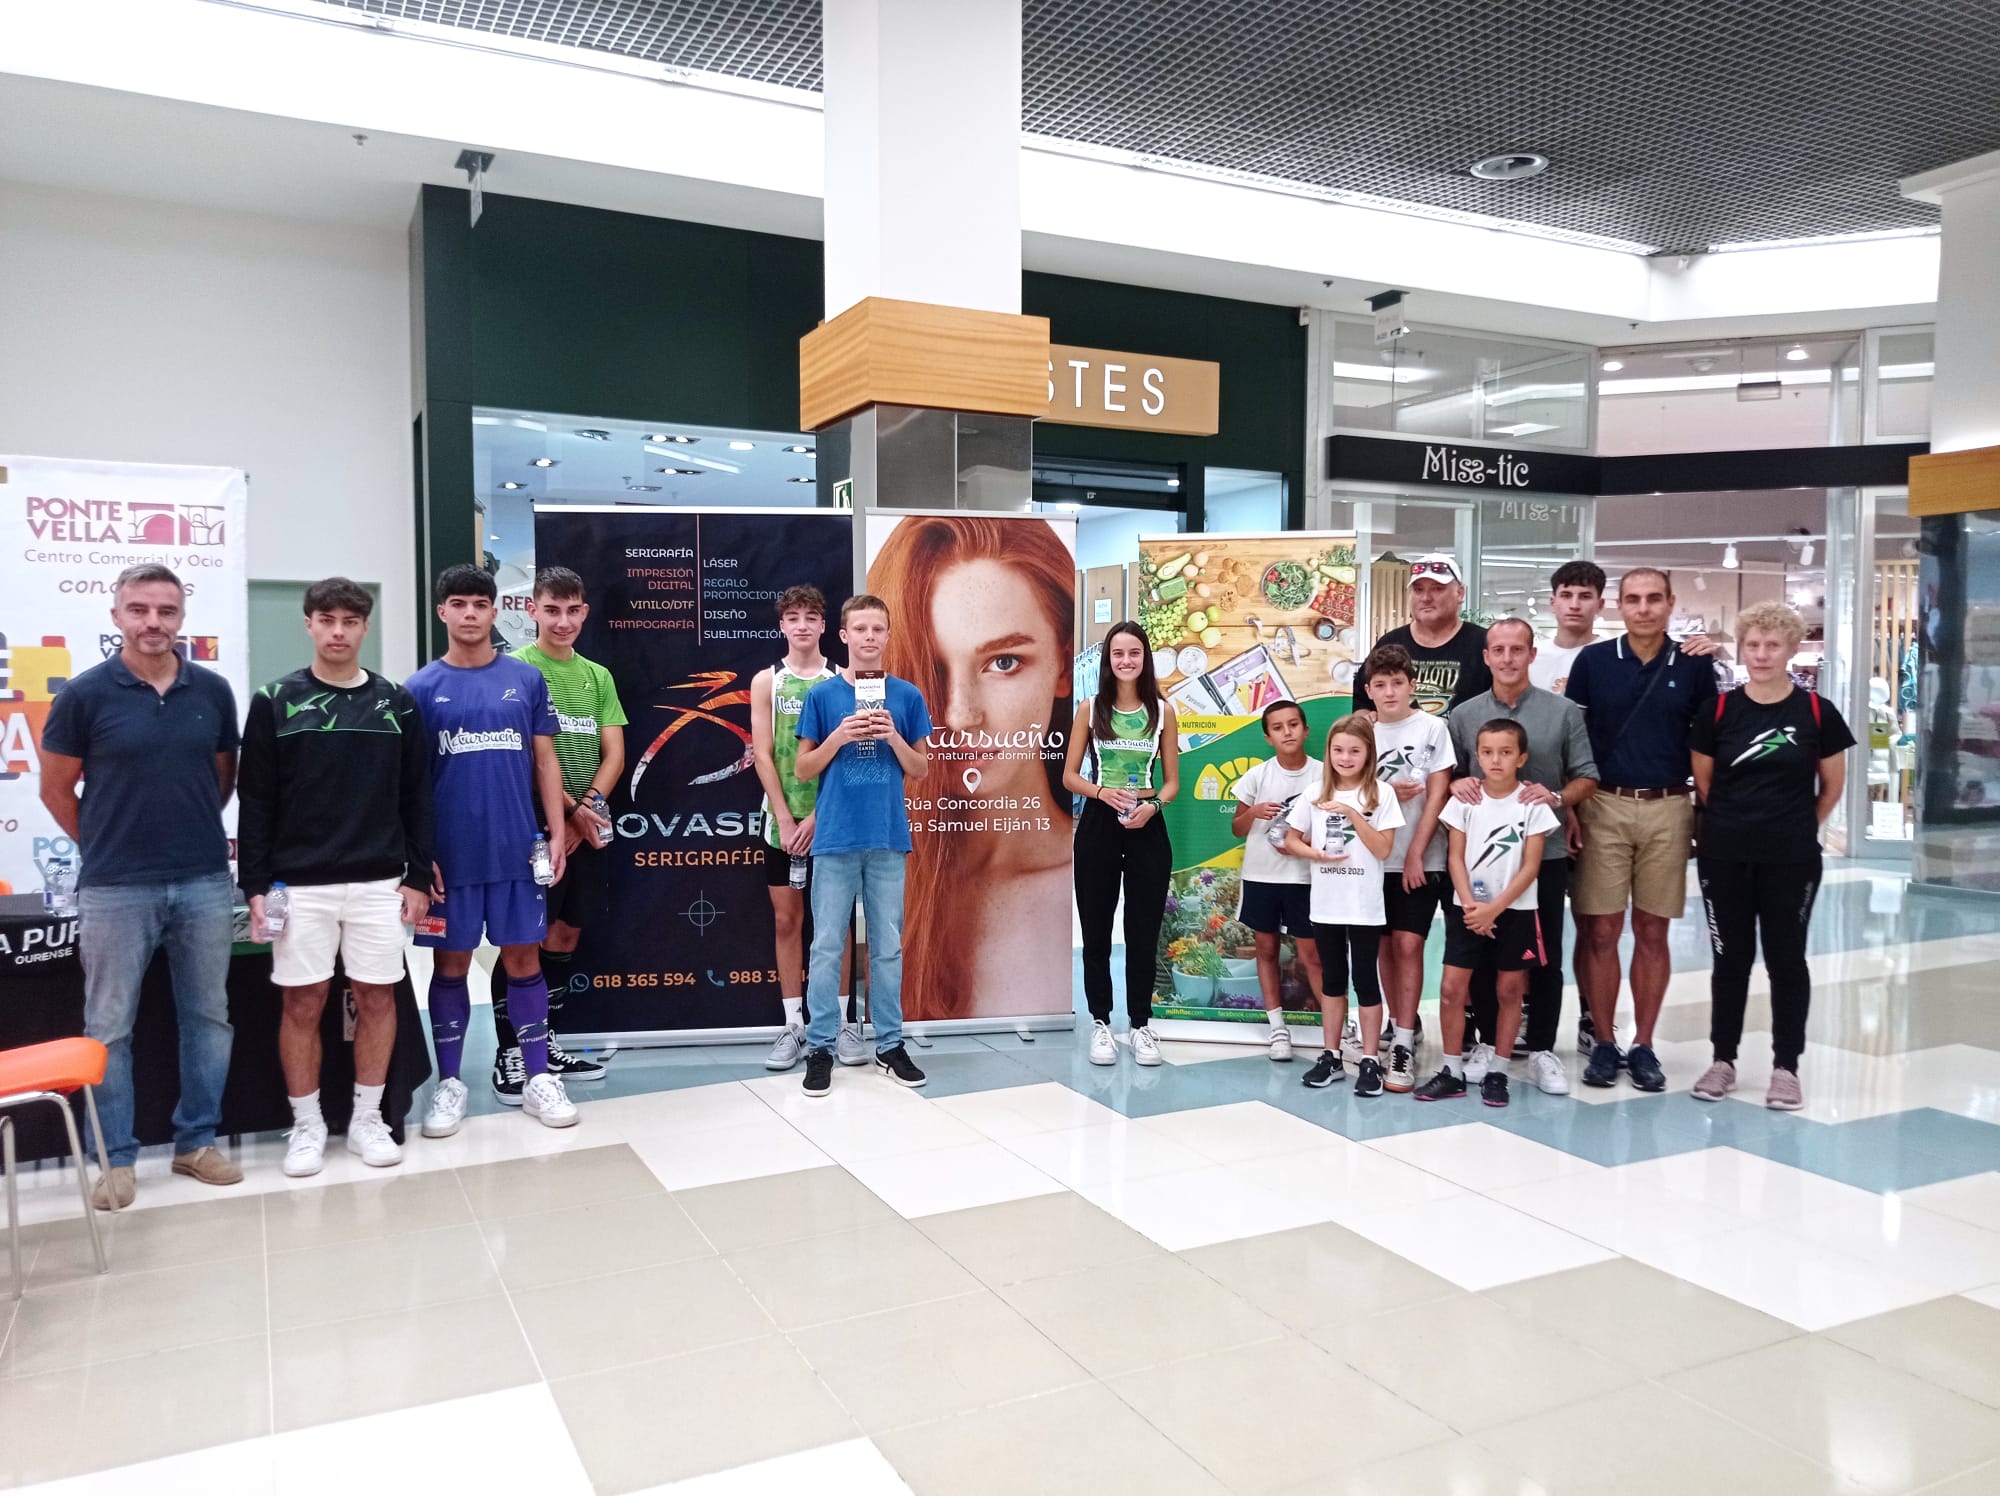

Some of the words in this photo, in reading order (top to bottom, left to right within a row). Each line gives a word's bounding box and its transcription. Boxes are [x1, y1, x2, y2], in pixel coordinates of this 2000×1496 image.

[1049, 359, 1165, 416] TES
[1421, 445, 1529, 487] Miss-tic
[26, 496, 123, 521] PONTE
[26, 519, 122, 543] VELLA
[625, 547, 694, 558] SERIGRAFÍA
[24, 549, 82, 564] Centro
[89, 551, 168, 566] Comercial
[173, 555, 183, 568] y
[188, 554, 223, 568] Ocio
[703, 557, 738, 568] LÁSER
[627, 567, 694, 578] IMPRESIÓN
[648, 580, 694, 590] DIGITAL
[703, 578, 748, 588] REGALO
[703, 590, 785, 600] PROMOCIONA
[630, 600, 695, 610] VINILO/DTF
[703, 609, 747, 620] DISEÑO
[608, 619, 695, 629] TAMPOGRAFÍA
[1181, 720, 1217, 729] NUTRICIÓN
[938, 750, 978, 760] natural
[981, 752, 994, 761] es
[997, 750, 1036, 761] dormir
[1039, 750, 1064, 760] bien
[937, 796, 1018, 810] Concordia
[1022, 796, 1041, 809] 26
[927, 817, 988, 832] Samuel
[993, 817, 1031, 834] Eiján
[1035, 817, 1051, 830] 13
[634, 846, 765, 867] SERIGRAFÍA
[1320, 866, 1346, 875] CAMPUS
[1348, 867, 1365, 876] 2023
[15, 947, 73, 965] OURENSE
[592, 974, 622, 988] 618
[626, 973, 658, 987] 365
[663, 972, 697, 986] 594
[729, 970, 762, 984] 988
